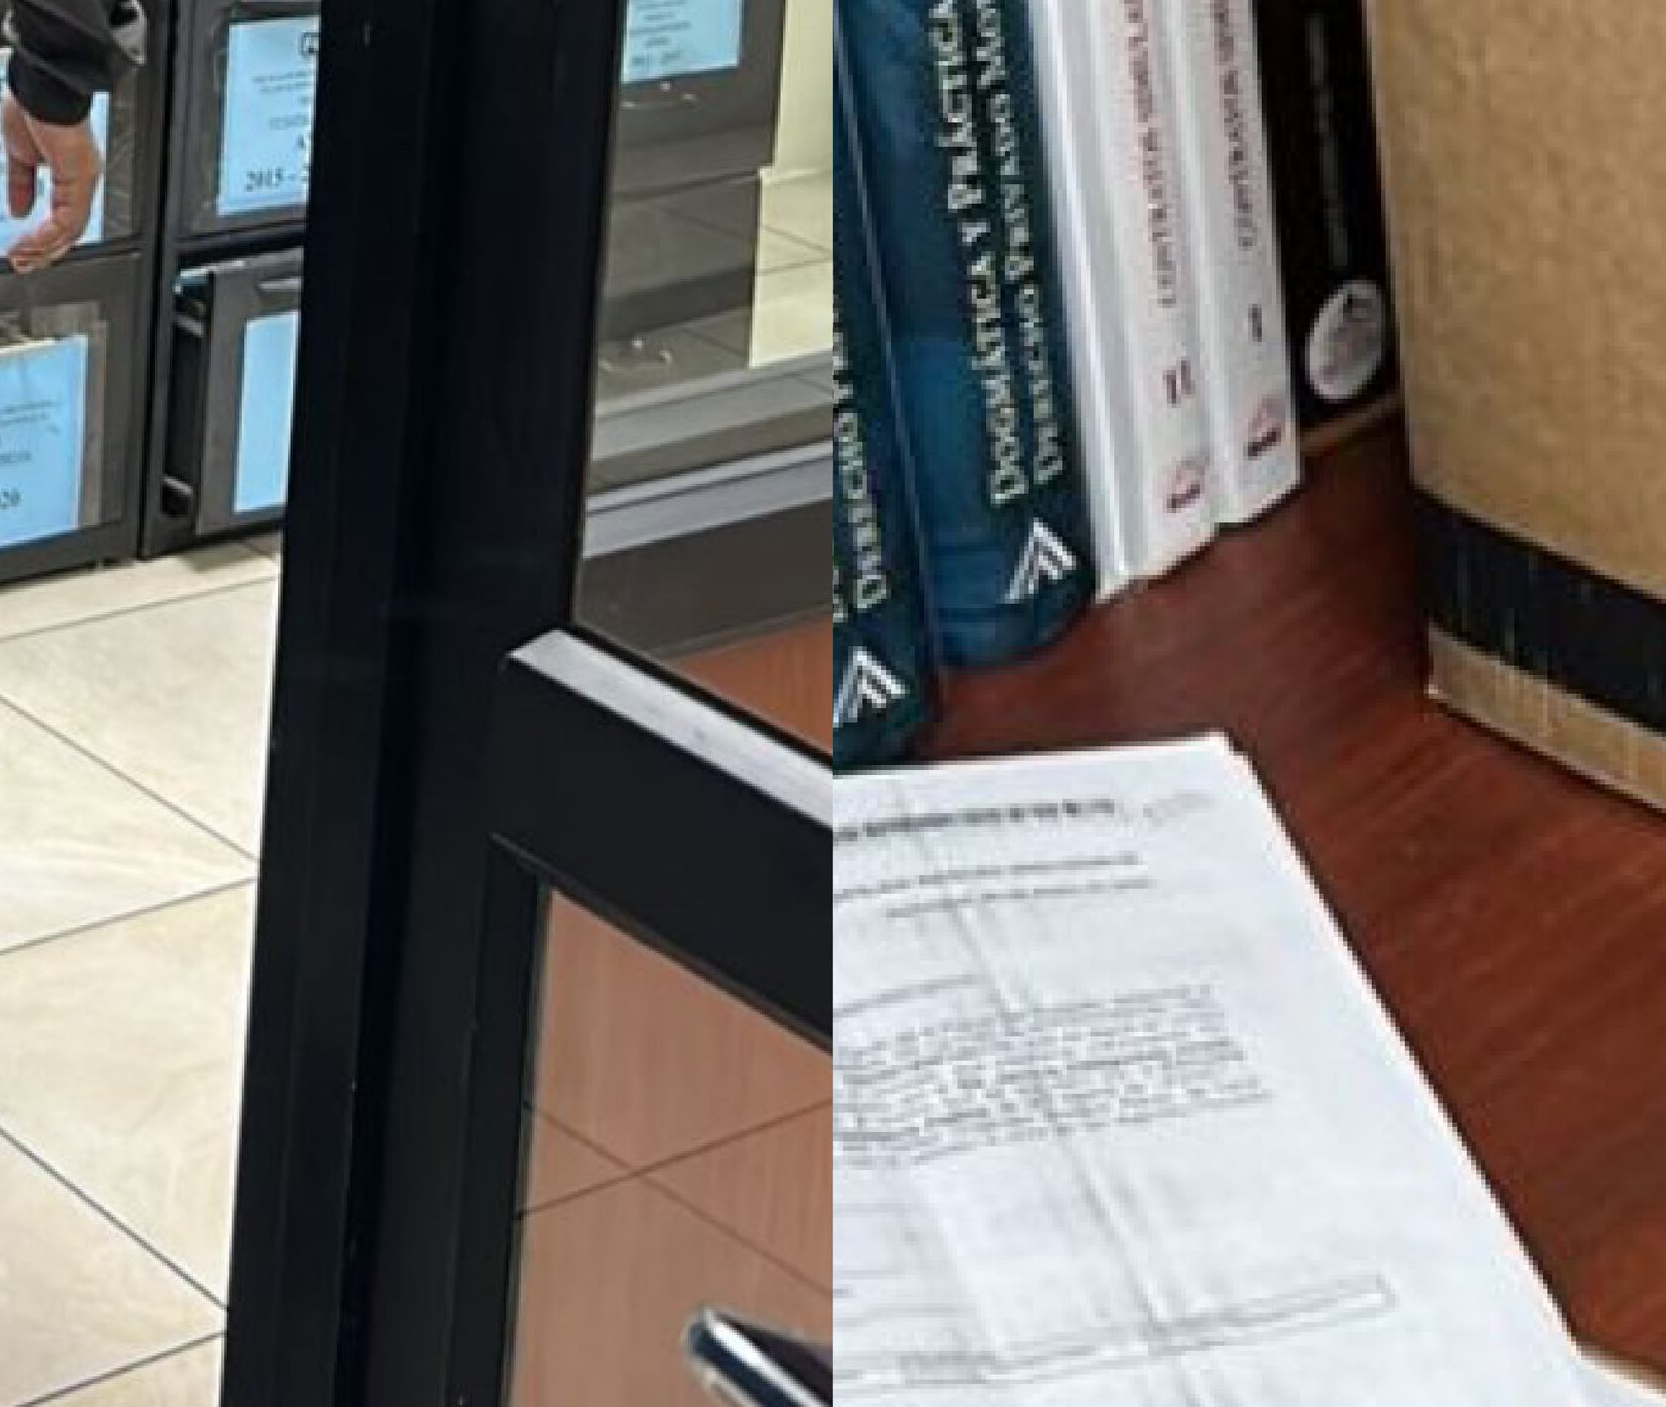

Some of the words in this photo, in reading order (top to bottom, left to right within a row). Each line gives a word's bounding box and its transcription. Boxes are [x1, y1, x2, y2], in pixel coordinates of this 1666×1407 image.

[959, 220, 993, 245] Y
[991, 92, 1034, 282] PRIVADO
[967, 250, 1030, 507] DOGMÁTICA
[1018, 284, 1064, 486] DERECHO
